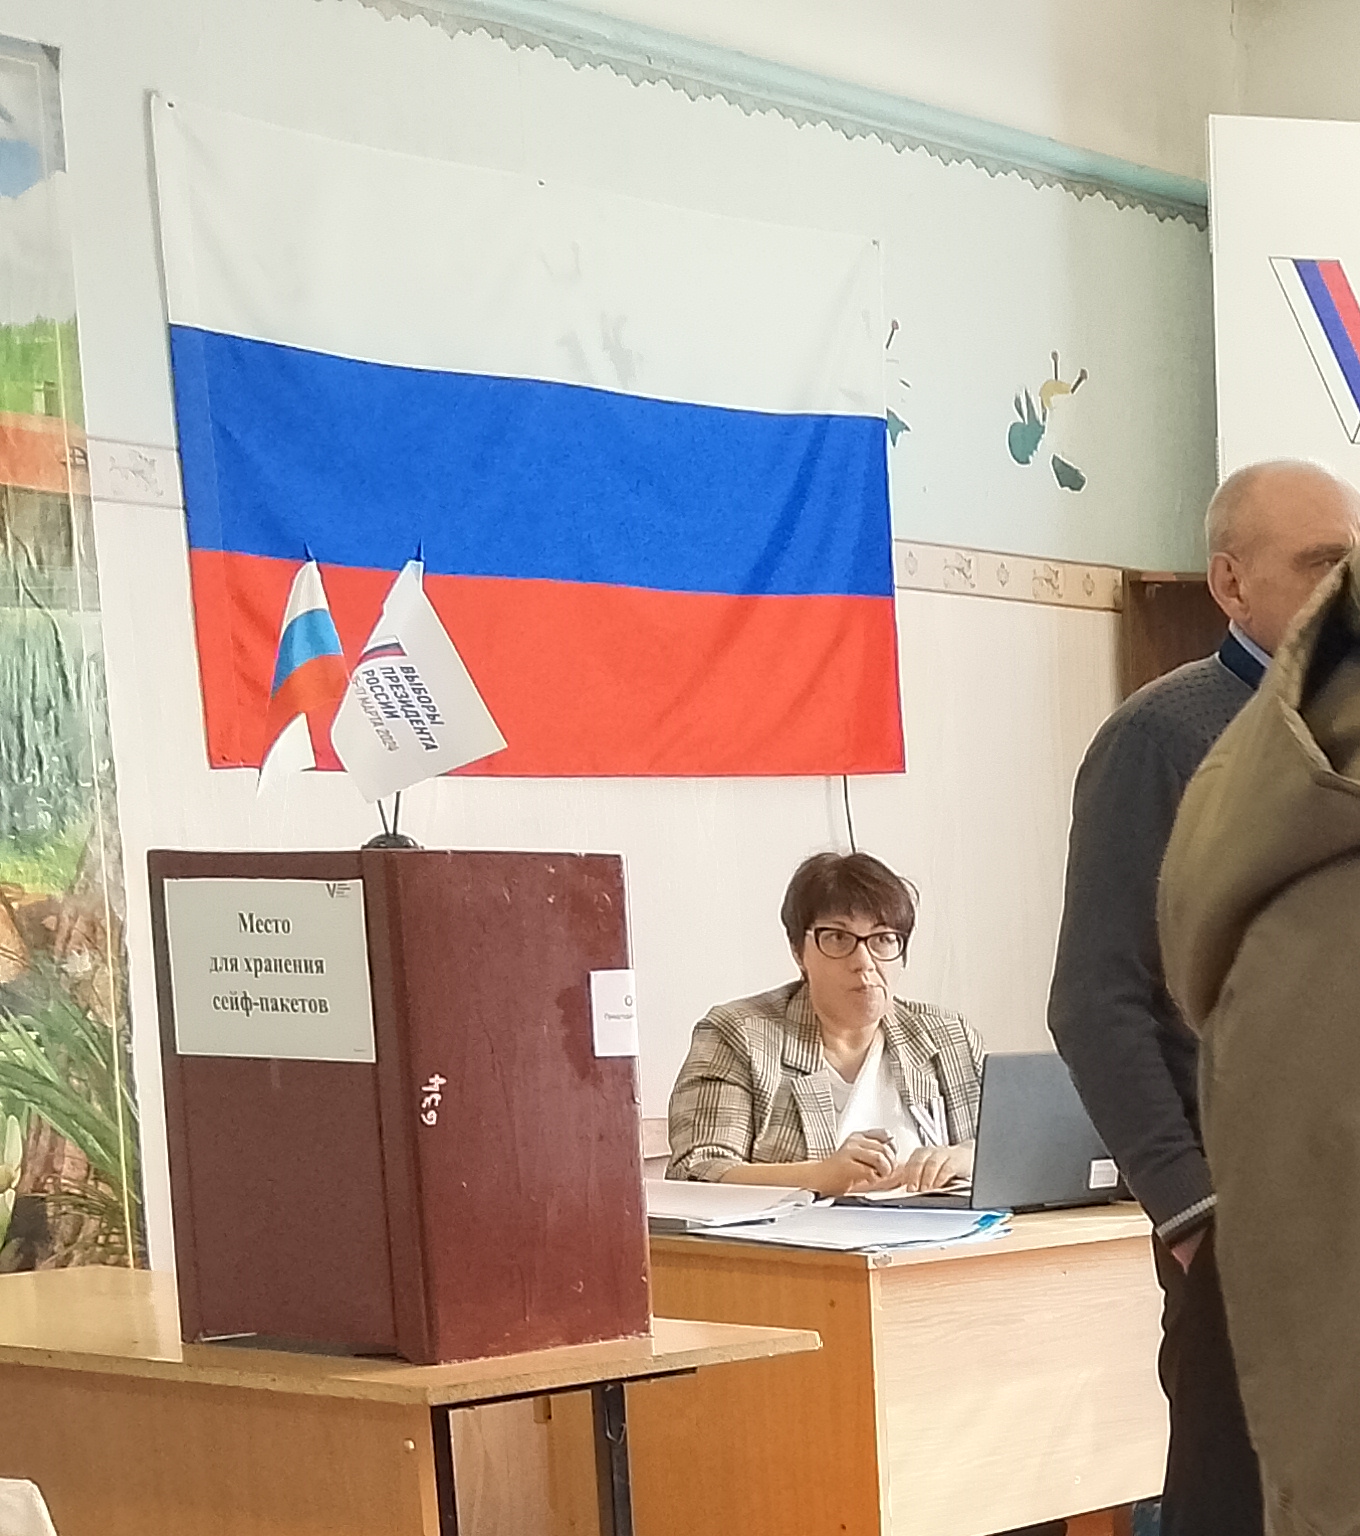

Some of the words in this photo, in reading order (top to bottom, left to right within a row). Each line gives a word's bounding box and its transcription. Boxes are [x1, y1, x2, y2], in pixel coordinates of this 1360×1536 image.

[362, 669, 401, 719] РОССИИ
[380, 667, 438, 750] ПРЕЗИДЕНТА
[400, 666, 444, 725] ВЫБОРЫ
[238, 912, 291, 934] Место
[210, 957, 239, 973] для
[244, 957, 325, 978] хранения
[212, 991, 329, 1017] сейф-пакетов
